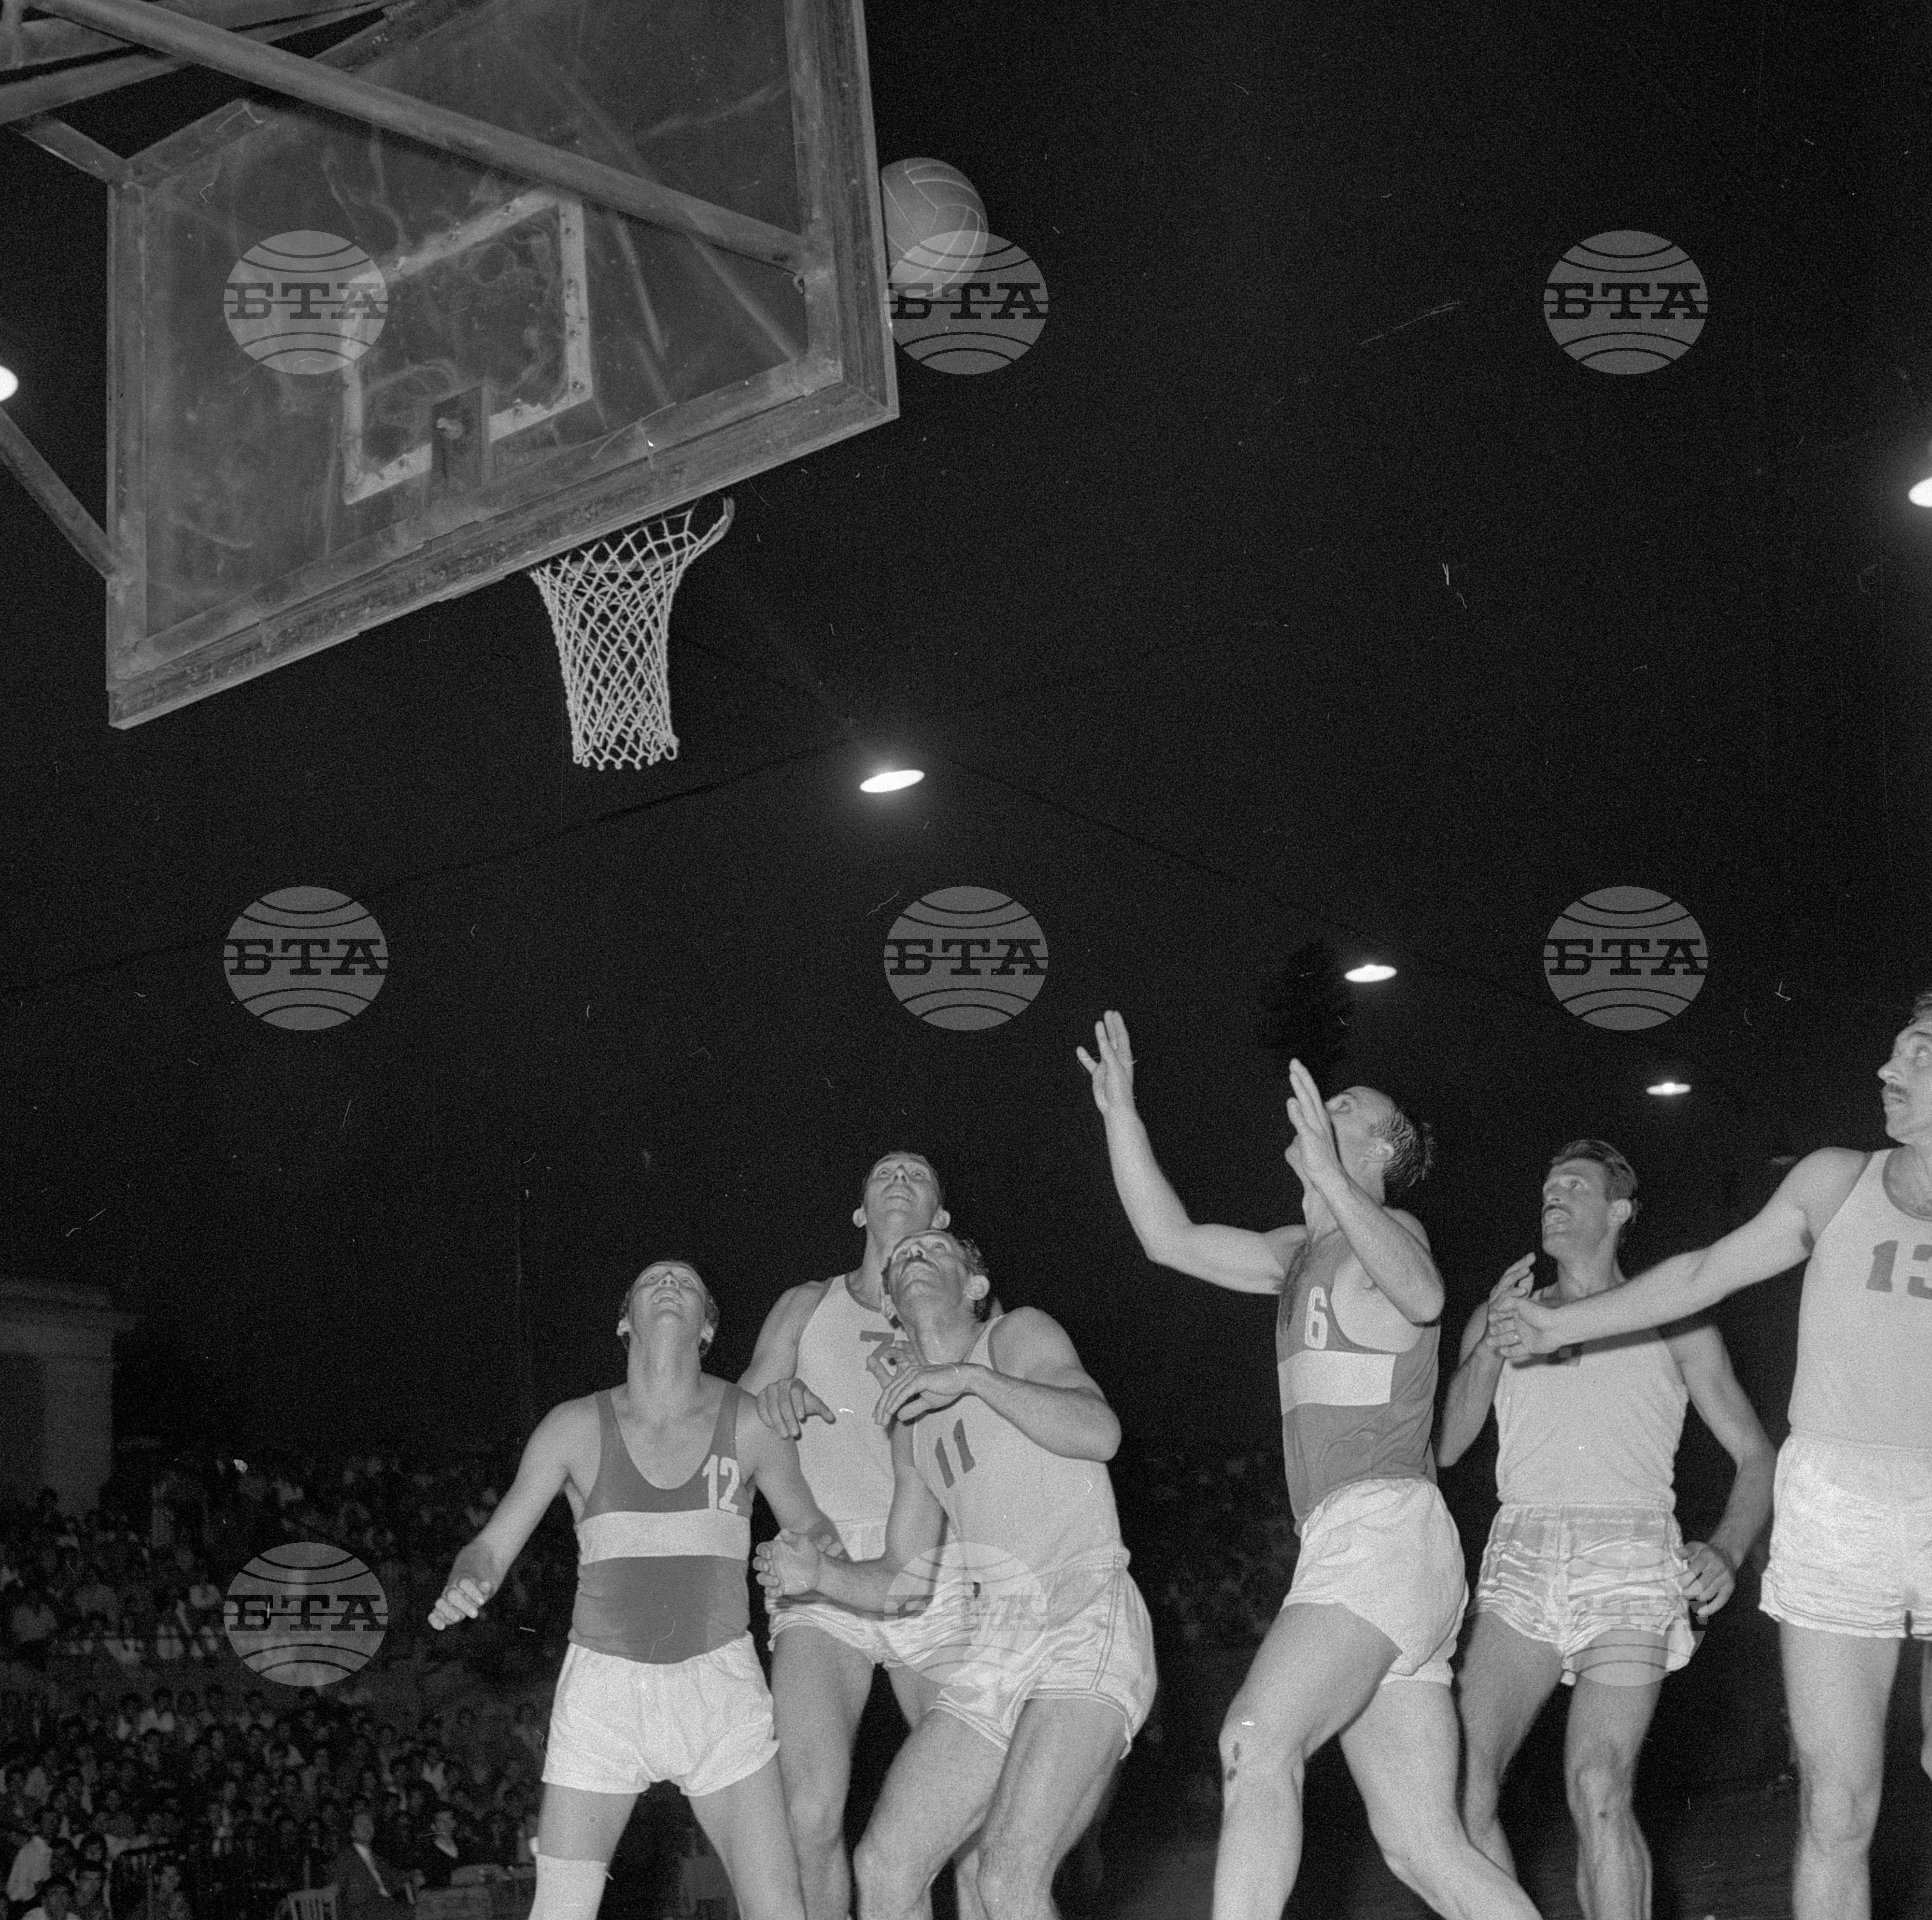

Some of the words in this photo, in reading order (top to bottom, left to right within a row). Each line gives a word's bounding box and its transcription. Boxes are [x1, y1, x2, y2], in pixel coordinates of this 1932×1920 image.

[1305, 1286, 1328, 1349] 6
[702, 1454, 739, 1514] 12
[935, 1418, 976, 1488] 11
